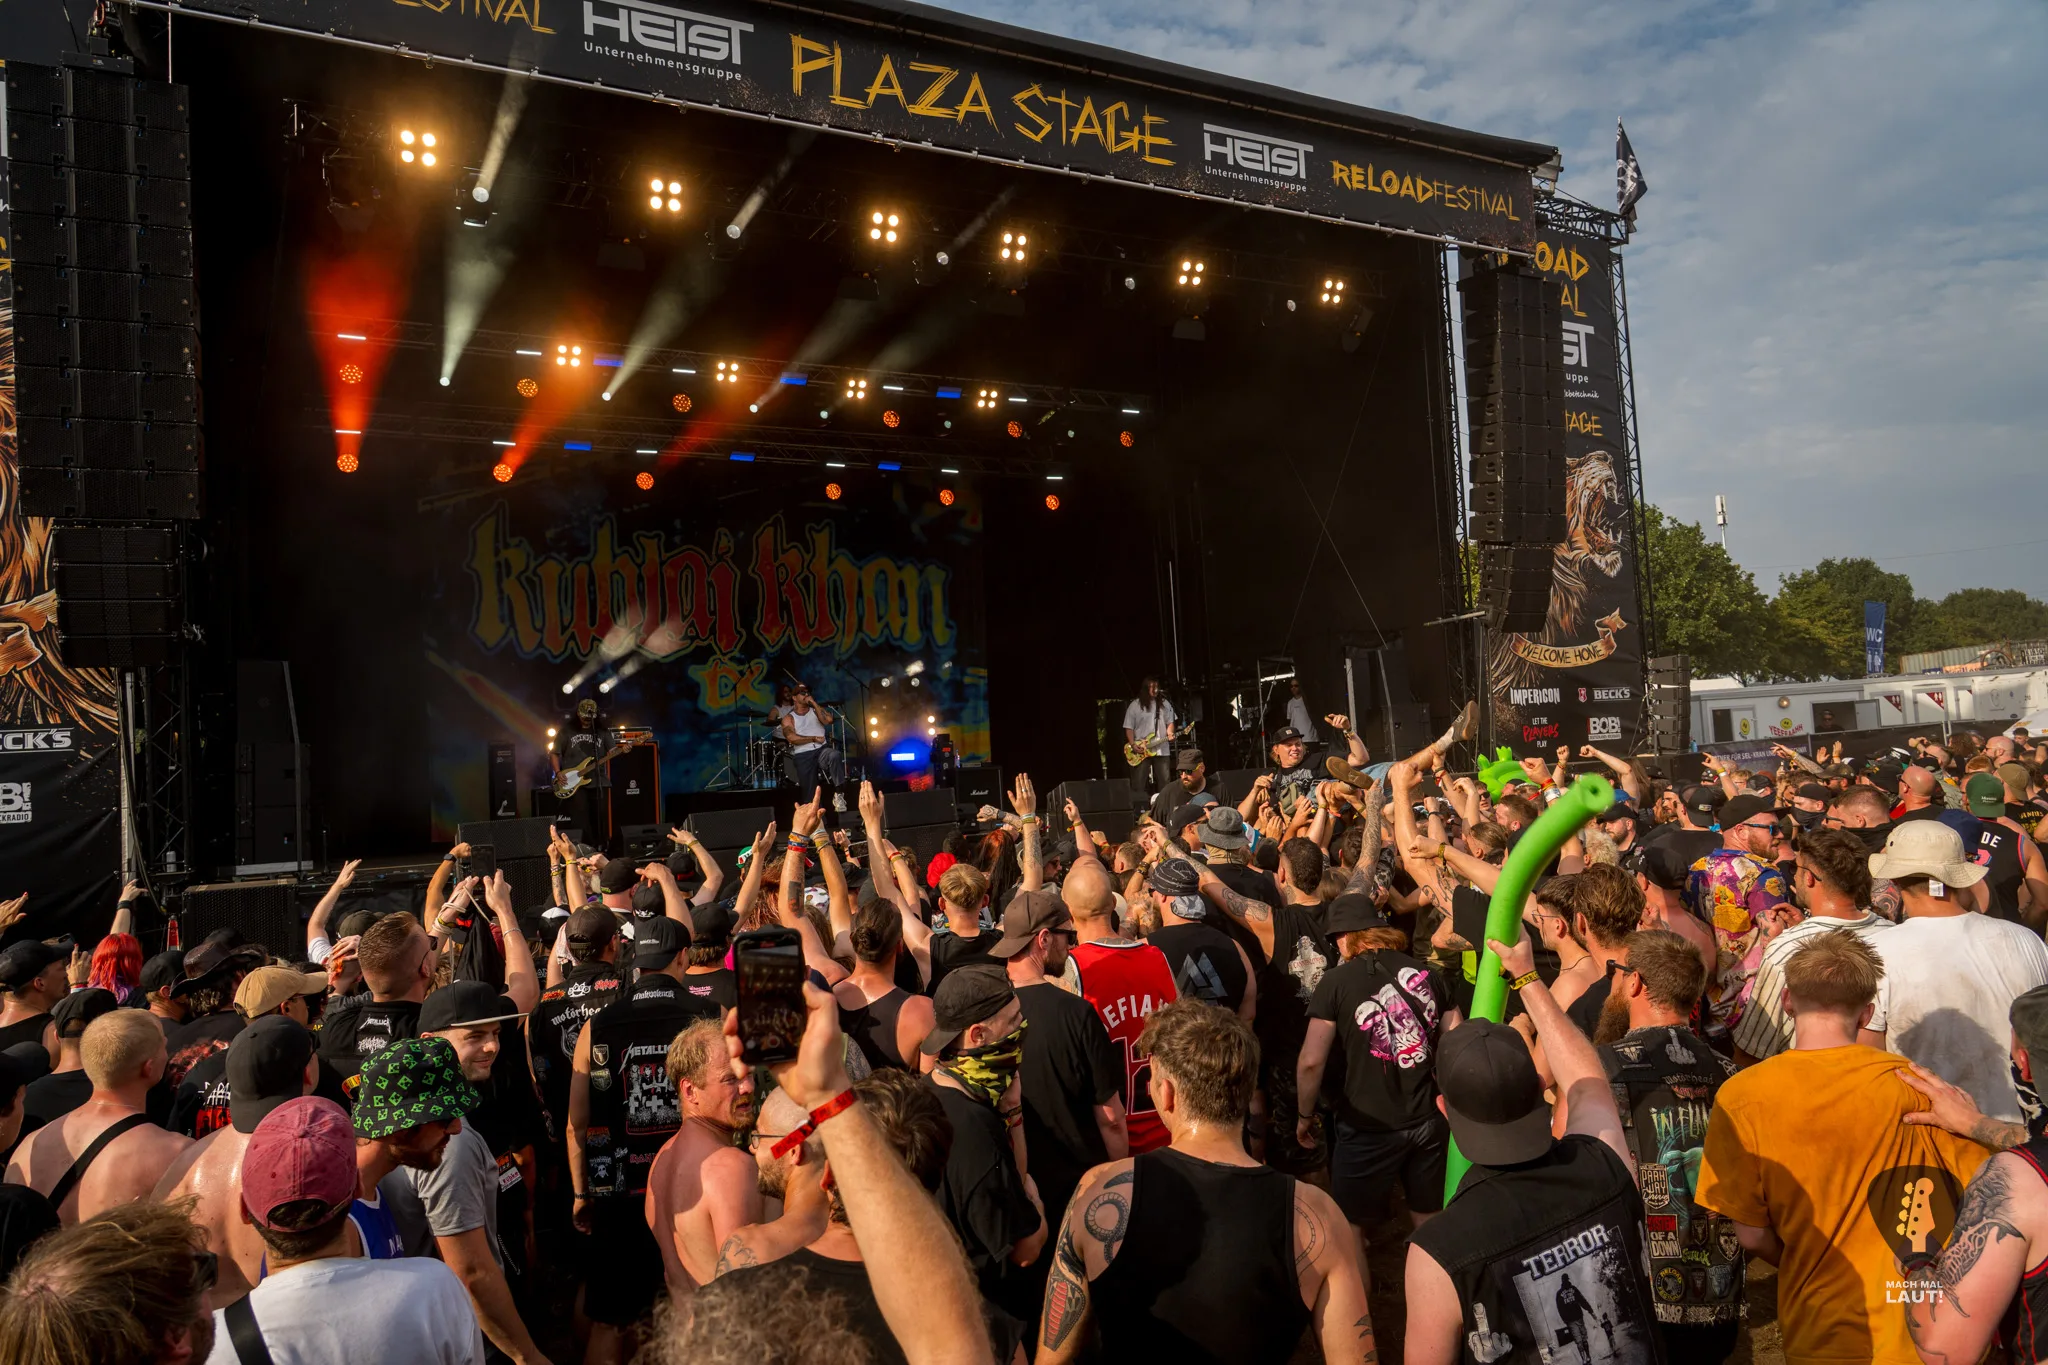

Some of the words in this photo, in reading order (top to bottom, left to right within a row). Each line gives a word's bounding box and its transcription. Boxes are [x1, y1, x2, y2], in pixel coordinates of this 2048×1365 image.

[583, 0, 754, 65] HEIST
[584, 41, 742, 81] Unternehmensgruppe
[789, 33, 1000, 134] PLAZA
[1011, 82, 1177, 166] STAGE
[1203, 123, 1314, 180] HEIST
[1204, 165, 1307, 193] Unternehmensgruppe
[1535, 241, 1590, 281] OAD
[1560, 283, 1588, 317] AL
[1565, 373, 1589, 384] uppe
[1565, 409, 1603, 436] TAGE
[1866, 627, 1883, 643] WC
[1521, 643, 1571, 664] WELCOME
[1573, 645, 1604, 662] HOME
[1510, 687, 1560, 706] IMPERICON
[1593, 687, 1631, 700] BECK'S
[1523, 722, 1559, 743] PLAYERS
[1590, 716, 1621, 734] BOB!
[0, 729, 72, 750] CK'S
[1753, 750, 1766, 758] KRAN
[1980, 831, 2002, 848] DE
[551, 1003, 609, 1026] motörhea
[1102, 994, 1170, 1032] EFIA
[1650, 1231, 1665, 1241] OF
[1667, 1231, 1677, 1241] A
[1521, 1223, 1610, 1281] TERROR
[1651, 1240, 1681, 1257] DOWN
